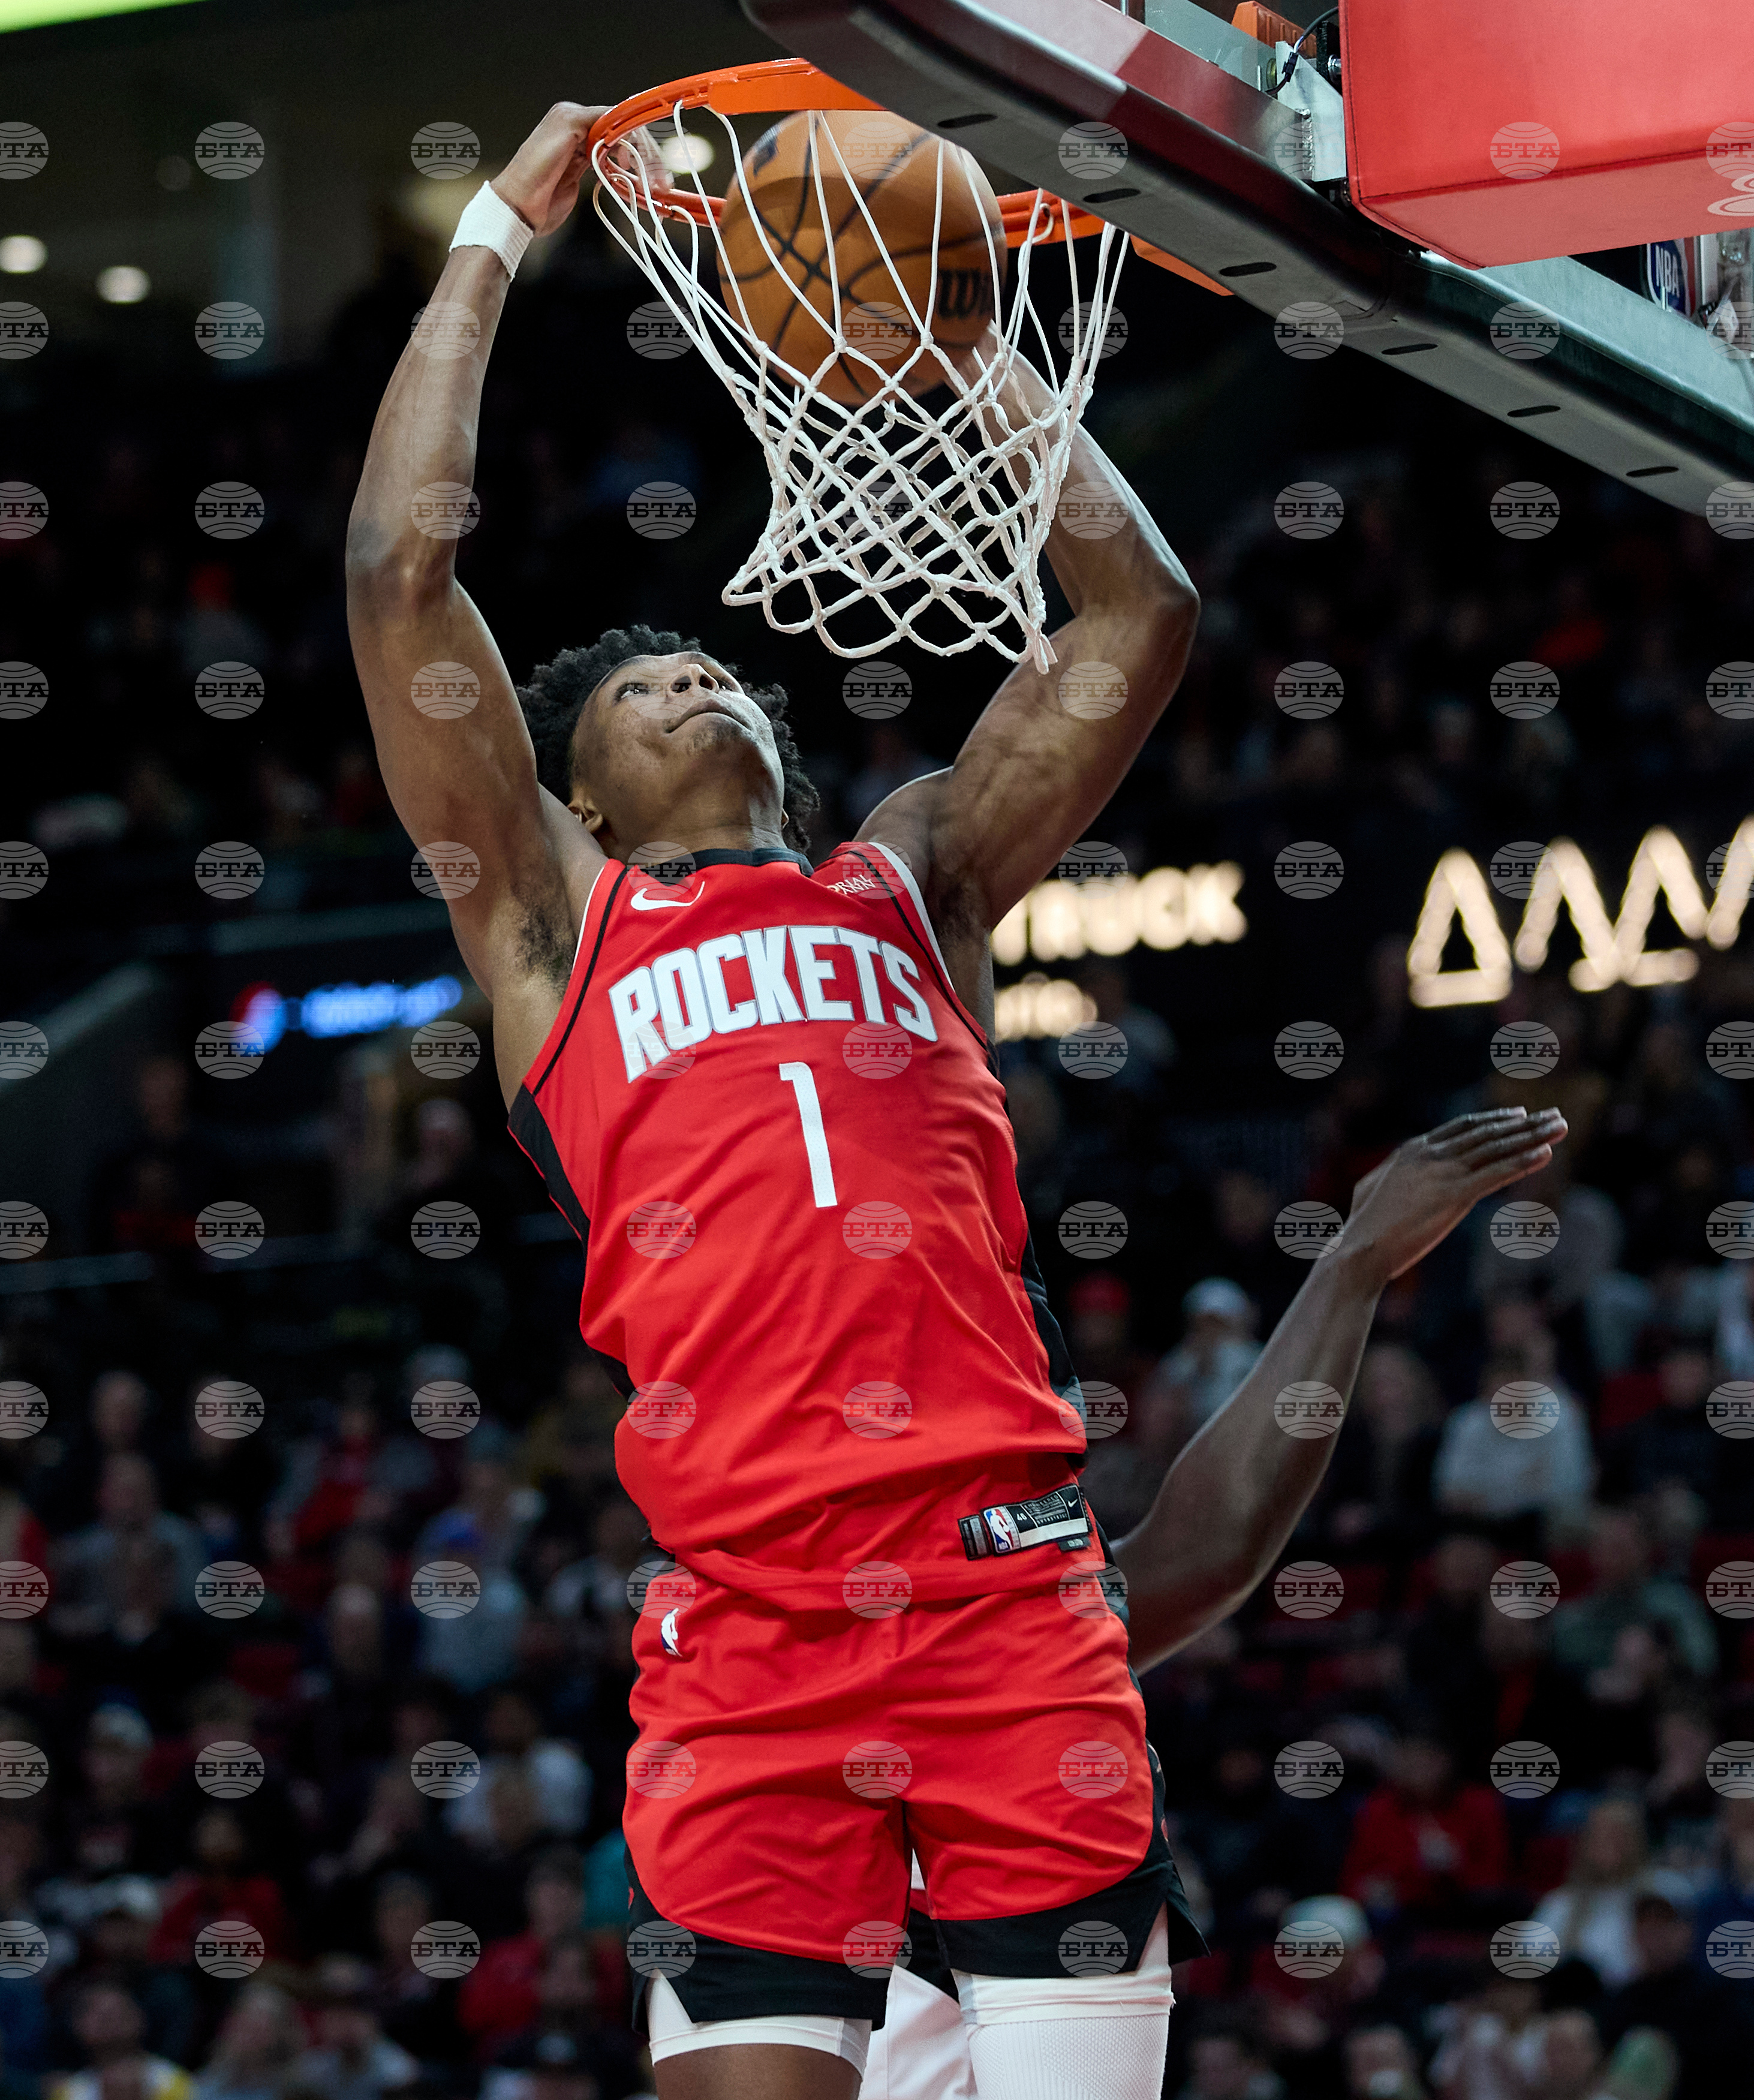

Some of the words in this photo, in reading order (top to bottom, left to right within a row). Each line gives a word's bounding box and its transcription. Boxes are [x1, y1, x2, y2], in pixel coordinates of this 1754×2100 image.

[1655, 244, 1680, 299] NBA
[608, 925, 938, 1084] ROCKETS
[778, 1061, 838, 1208] 1
